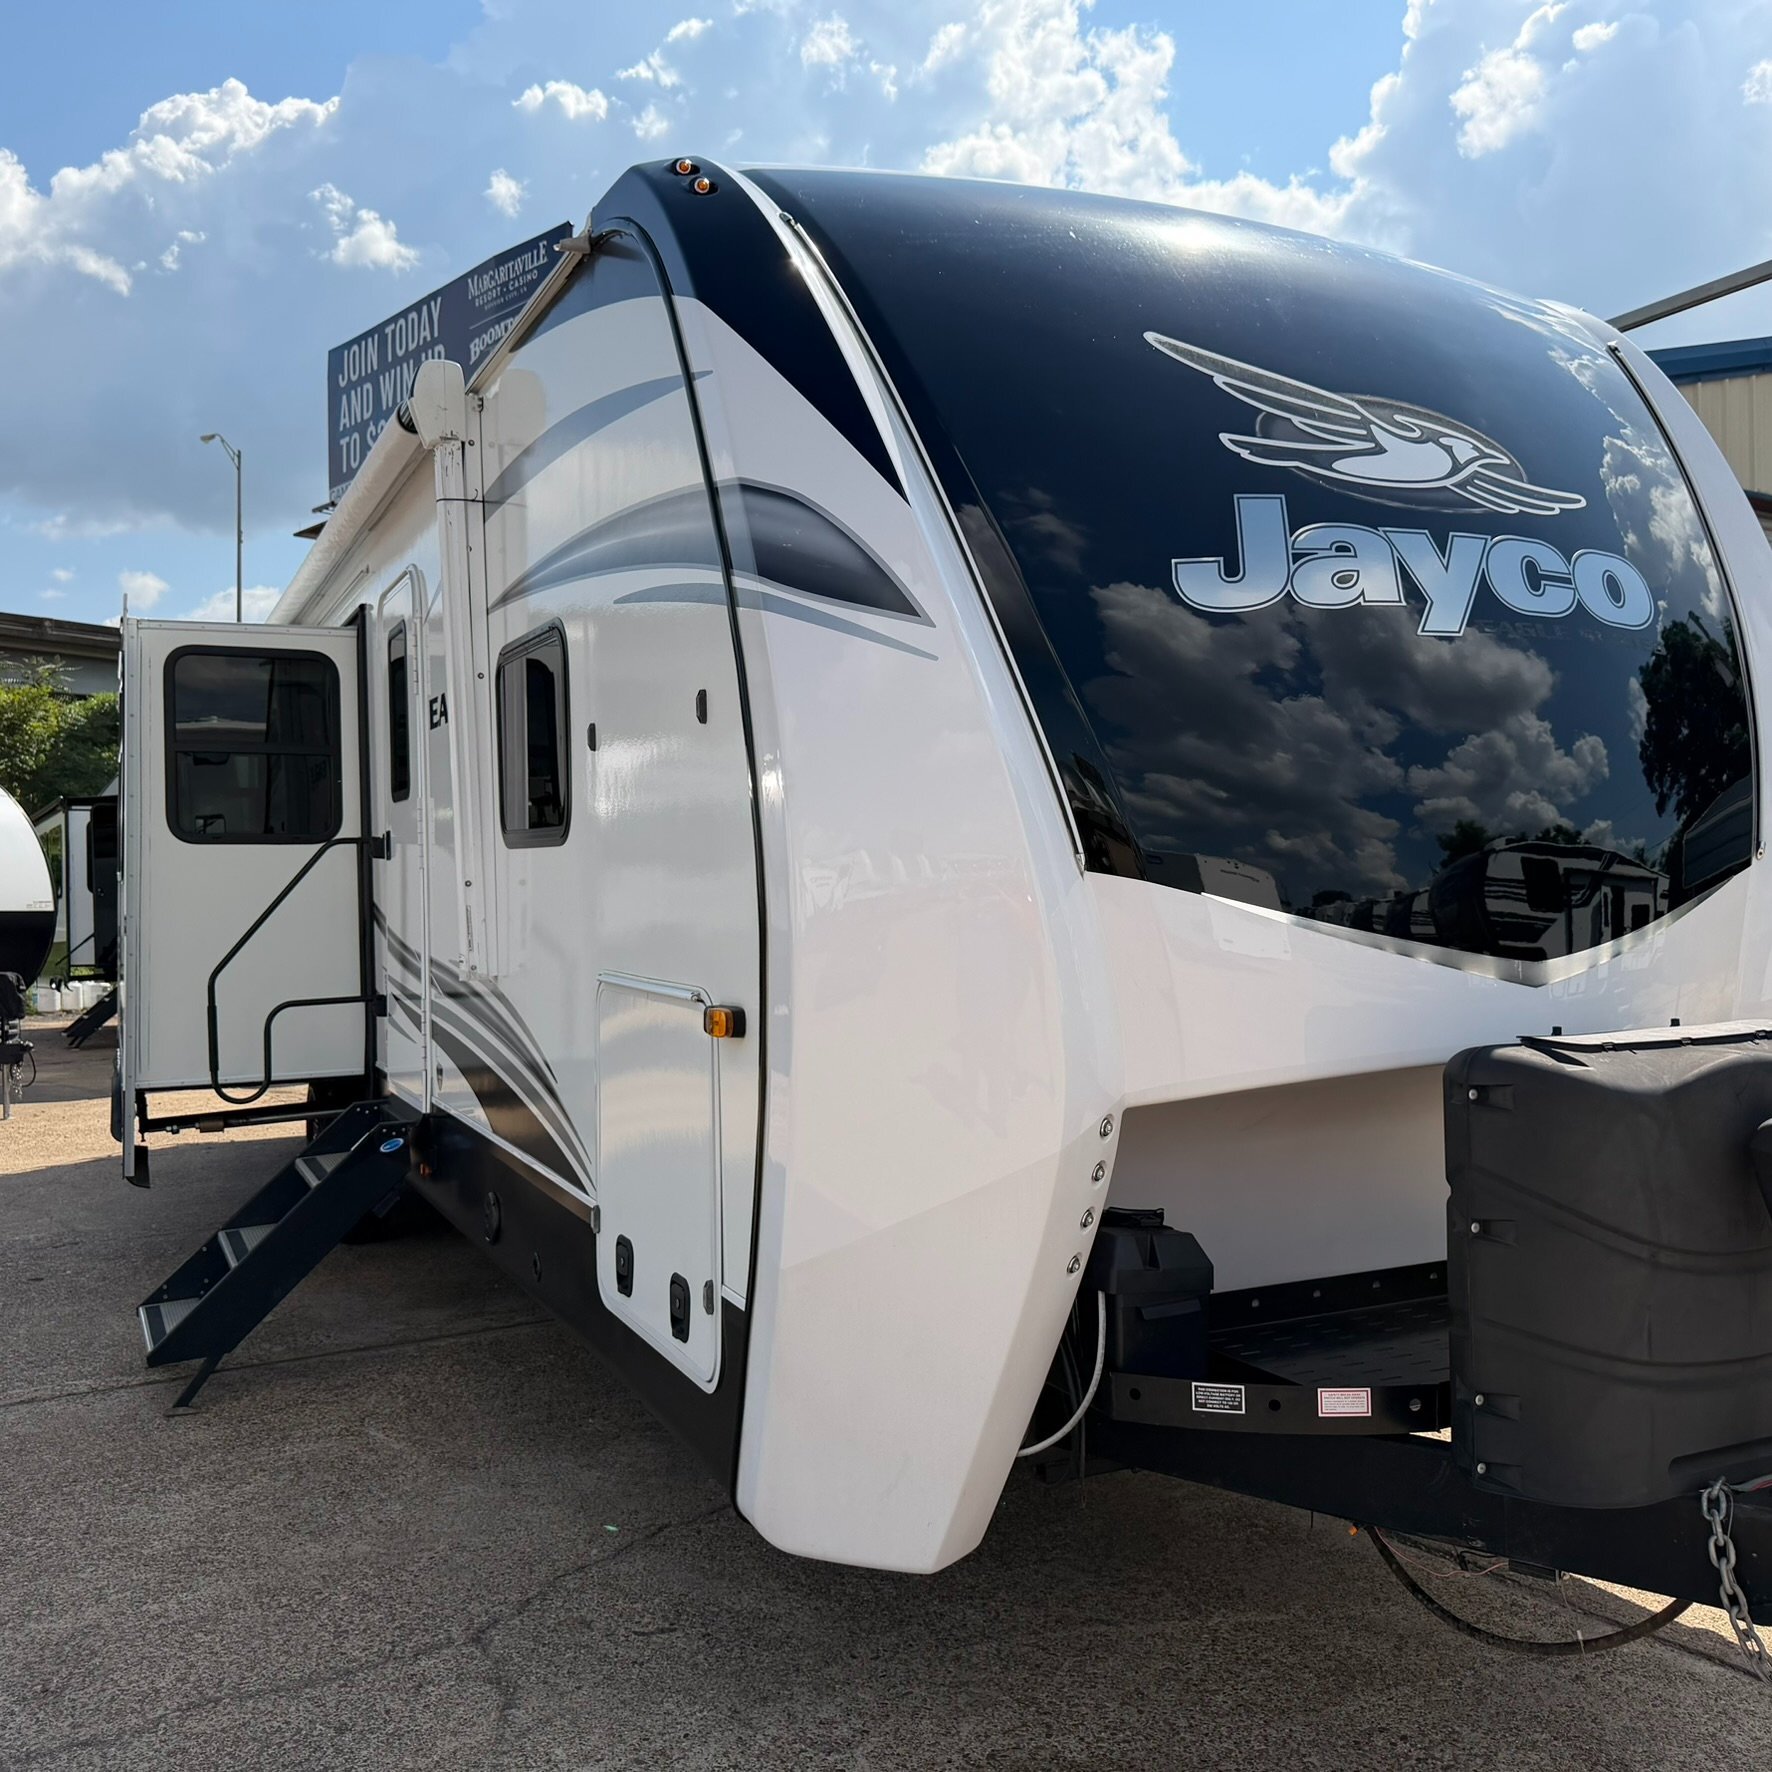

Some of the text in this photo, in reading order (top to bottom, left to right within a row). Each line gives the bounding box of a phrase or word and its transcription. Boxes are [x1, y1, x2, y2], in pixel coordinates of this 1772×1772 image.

[468, 241, 548, 300] MARGARITAVILLE
[475, 286, 501, 308] RESORT
[508, 269, 538, 290] CASINO
[338, 333, 378, 388] JOIN
[385, 296, 442, 362] TODAY
[469, 315, 520, 366] BOOMT
[339, 382, 373, 431] AND
[340, 431, 360, 473] TO
[1171, 494, 1655, 636] Jayco
